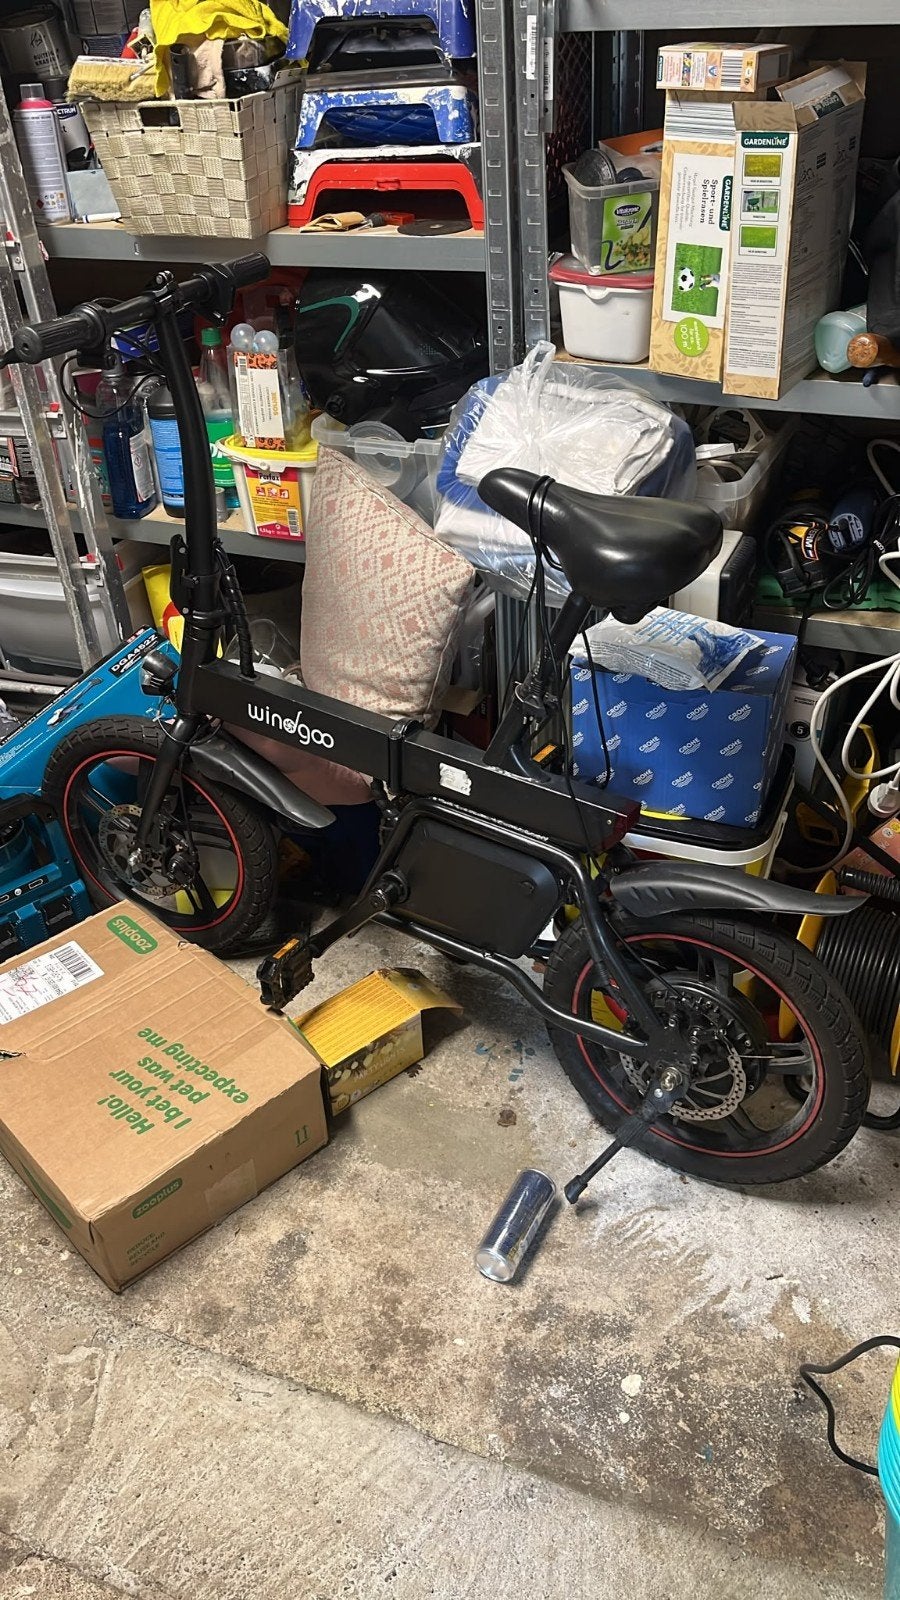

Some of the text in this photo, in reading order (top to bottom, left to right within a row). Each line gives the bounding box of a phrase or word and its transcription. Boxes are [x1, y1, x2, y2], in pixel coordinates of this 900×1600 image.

[744, 137, 788, 146] GARDENLINE
[699, 178, 710, 224] Spielrasen
[707, 178, 719, 226] Sport- und
[721, 179, 731, 229] GARDENLINE
[680, 324, 690, 339] 100
[606, 700, 627, 717] GROHE
[645, 701, 667, 718] GROHE
[686, 702, 709, 719] GROHE
[728, 704, 751, 721] GROHE
[247, 703, 335, 750] windgoo
[796, 725, 804, 734] 5
[639, 736, 660, 752] GROHE
[678, 737, 701, 753] GROHE
[720, 738, 743, 755] GROHE
[633, 769, 653, 783] GROHE
[671, 771, 692, 787] GROHE
[711, 772, 734, 789] GROHE
[704, 805, 725, 821] GROHE
[112, 918, 153, 951] zooplus
[137, 1028, 250, 1104] expecting me
[108, 1069, 158, 1099] your
[137, 1056, 211, 1105] pet was
[97, 1094, 155, 1135] Hello!
[146, 1094, 183, 1124] bet
[135, 1181, 181, 1217] zooplus
